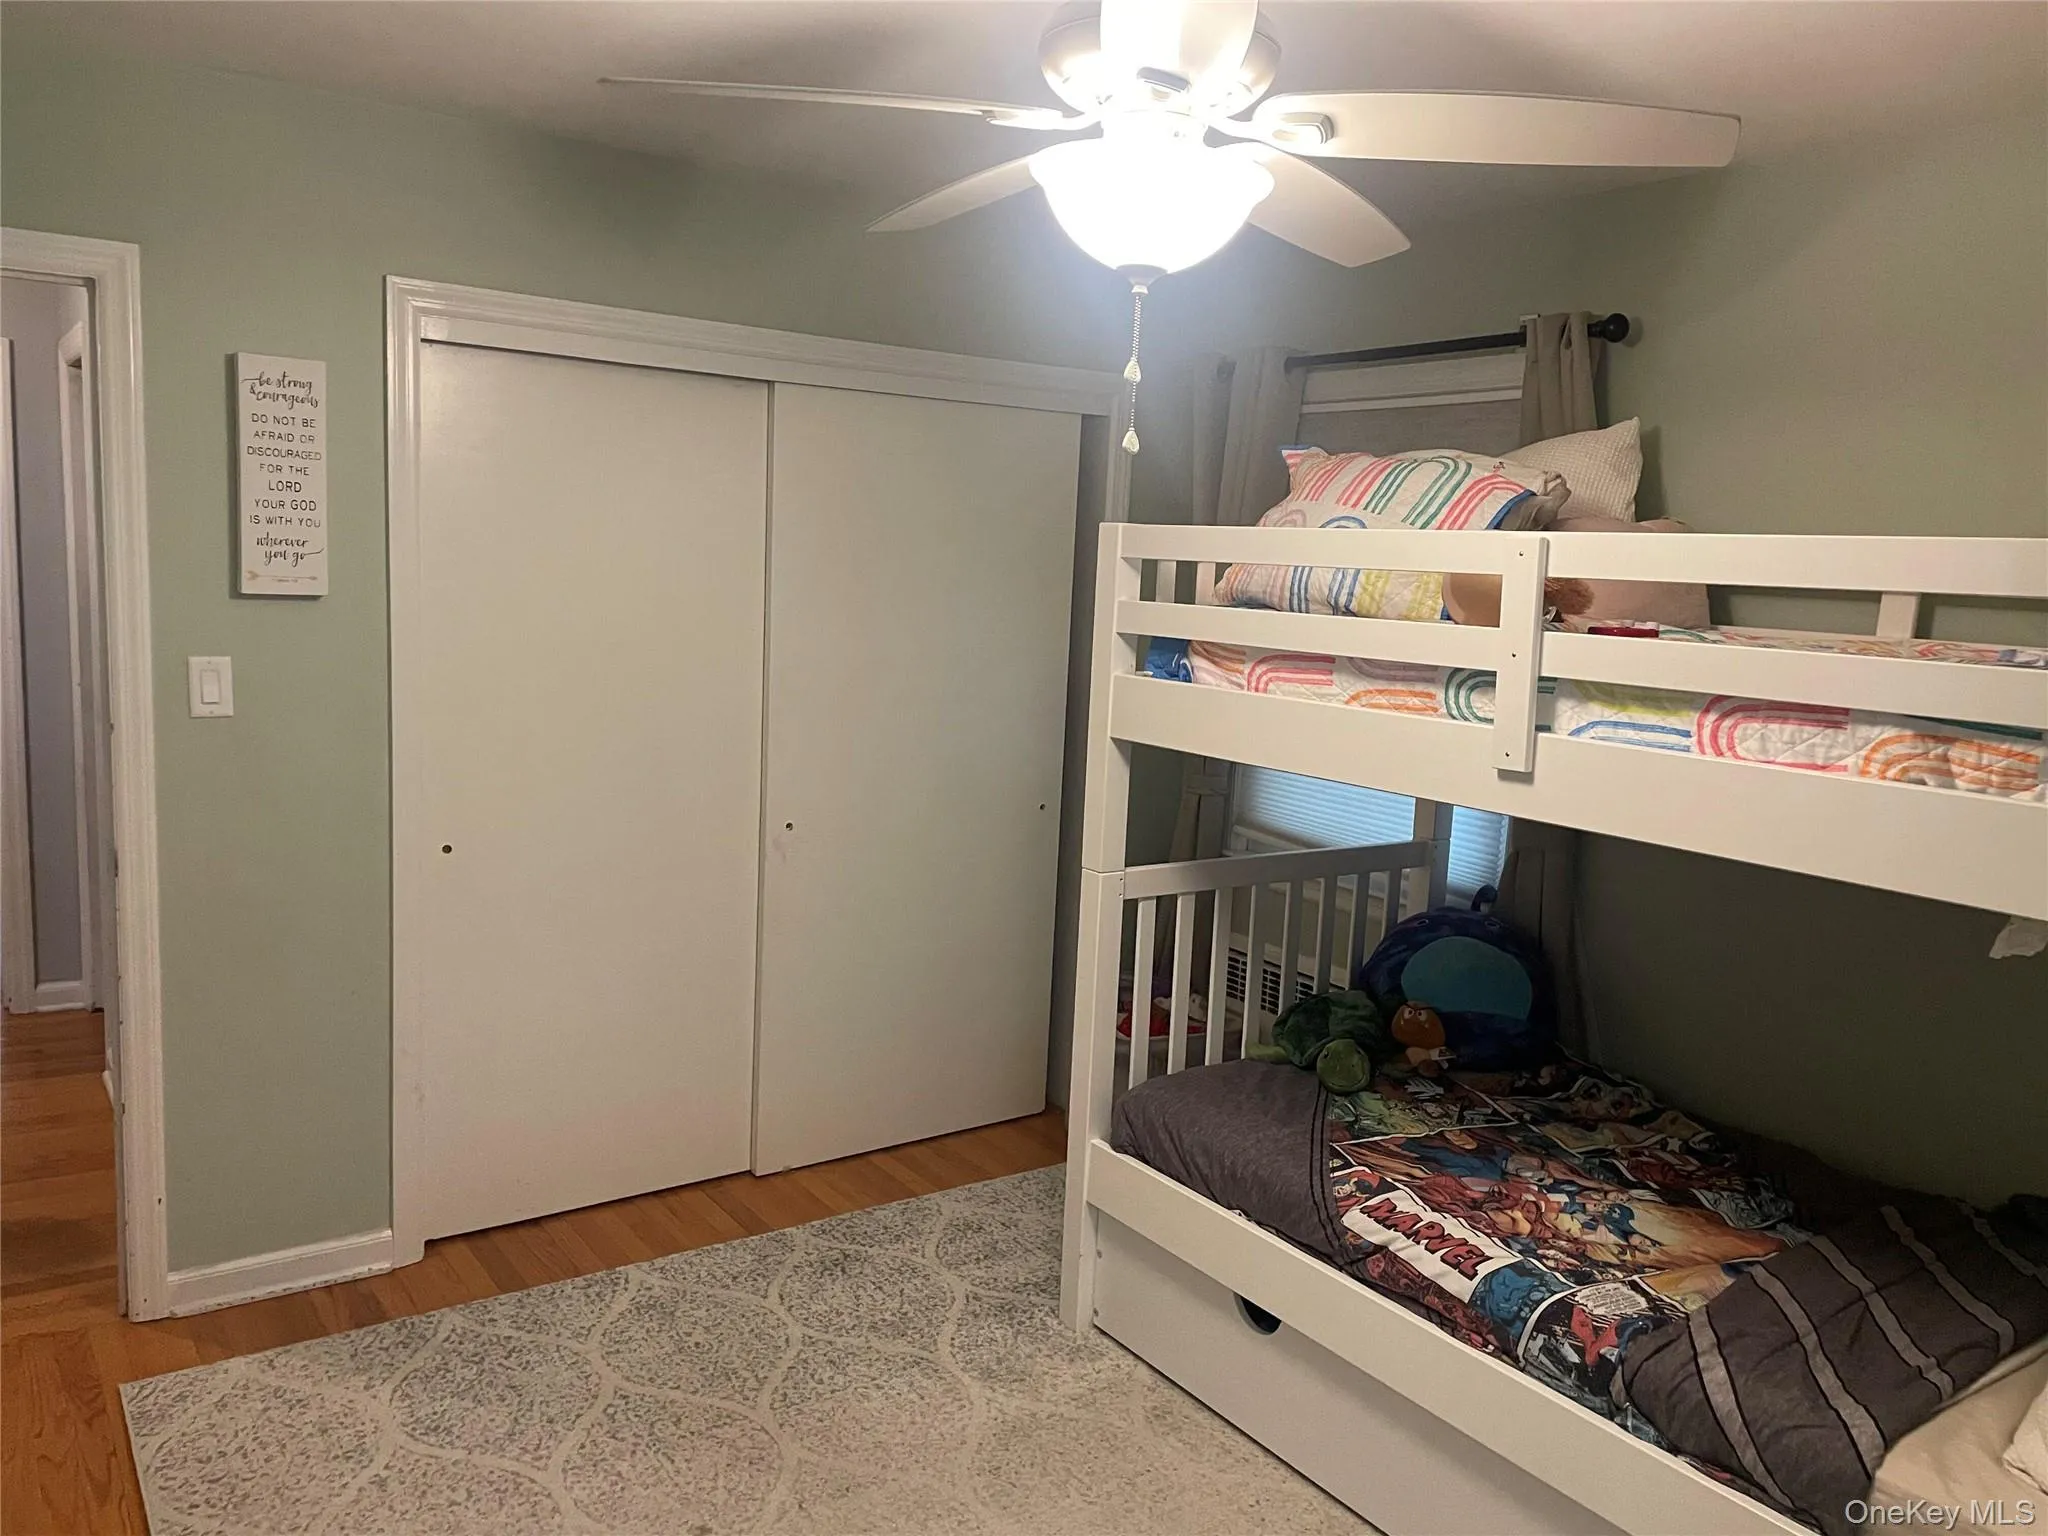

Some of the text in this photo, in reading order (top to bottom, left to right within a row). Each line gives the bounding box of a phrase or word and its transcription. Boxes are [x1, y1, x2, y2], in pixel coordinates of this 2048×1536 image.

[277, 370, 312, 394] strong
[251, 413, 316, 428] DO NOT BE
[253, 430, 316, 444] AFRAID OR
[247, 445, 322, 461] DISCOURAGED
[259, 463, 310, 476] FOR THE
[268, 480, 302, 493] LORD
[254, 498, 317, 512] YOUR GOD
[249, 514, 321, 528] IS WITH YOU
[256, 531, 310, 548] wherever
[264, 550, 287, 567] you
[1359, 1197, 1494, 1282] MARVEL
